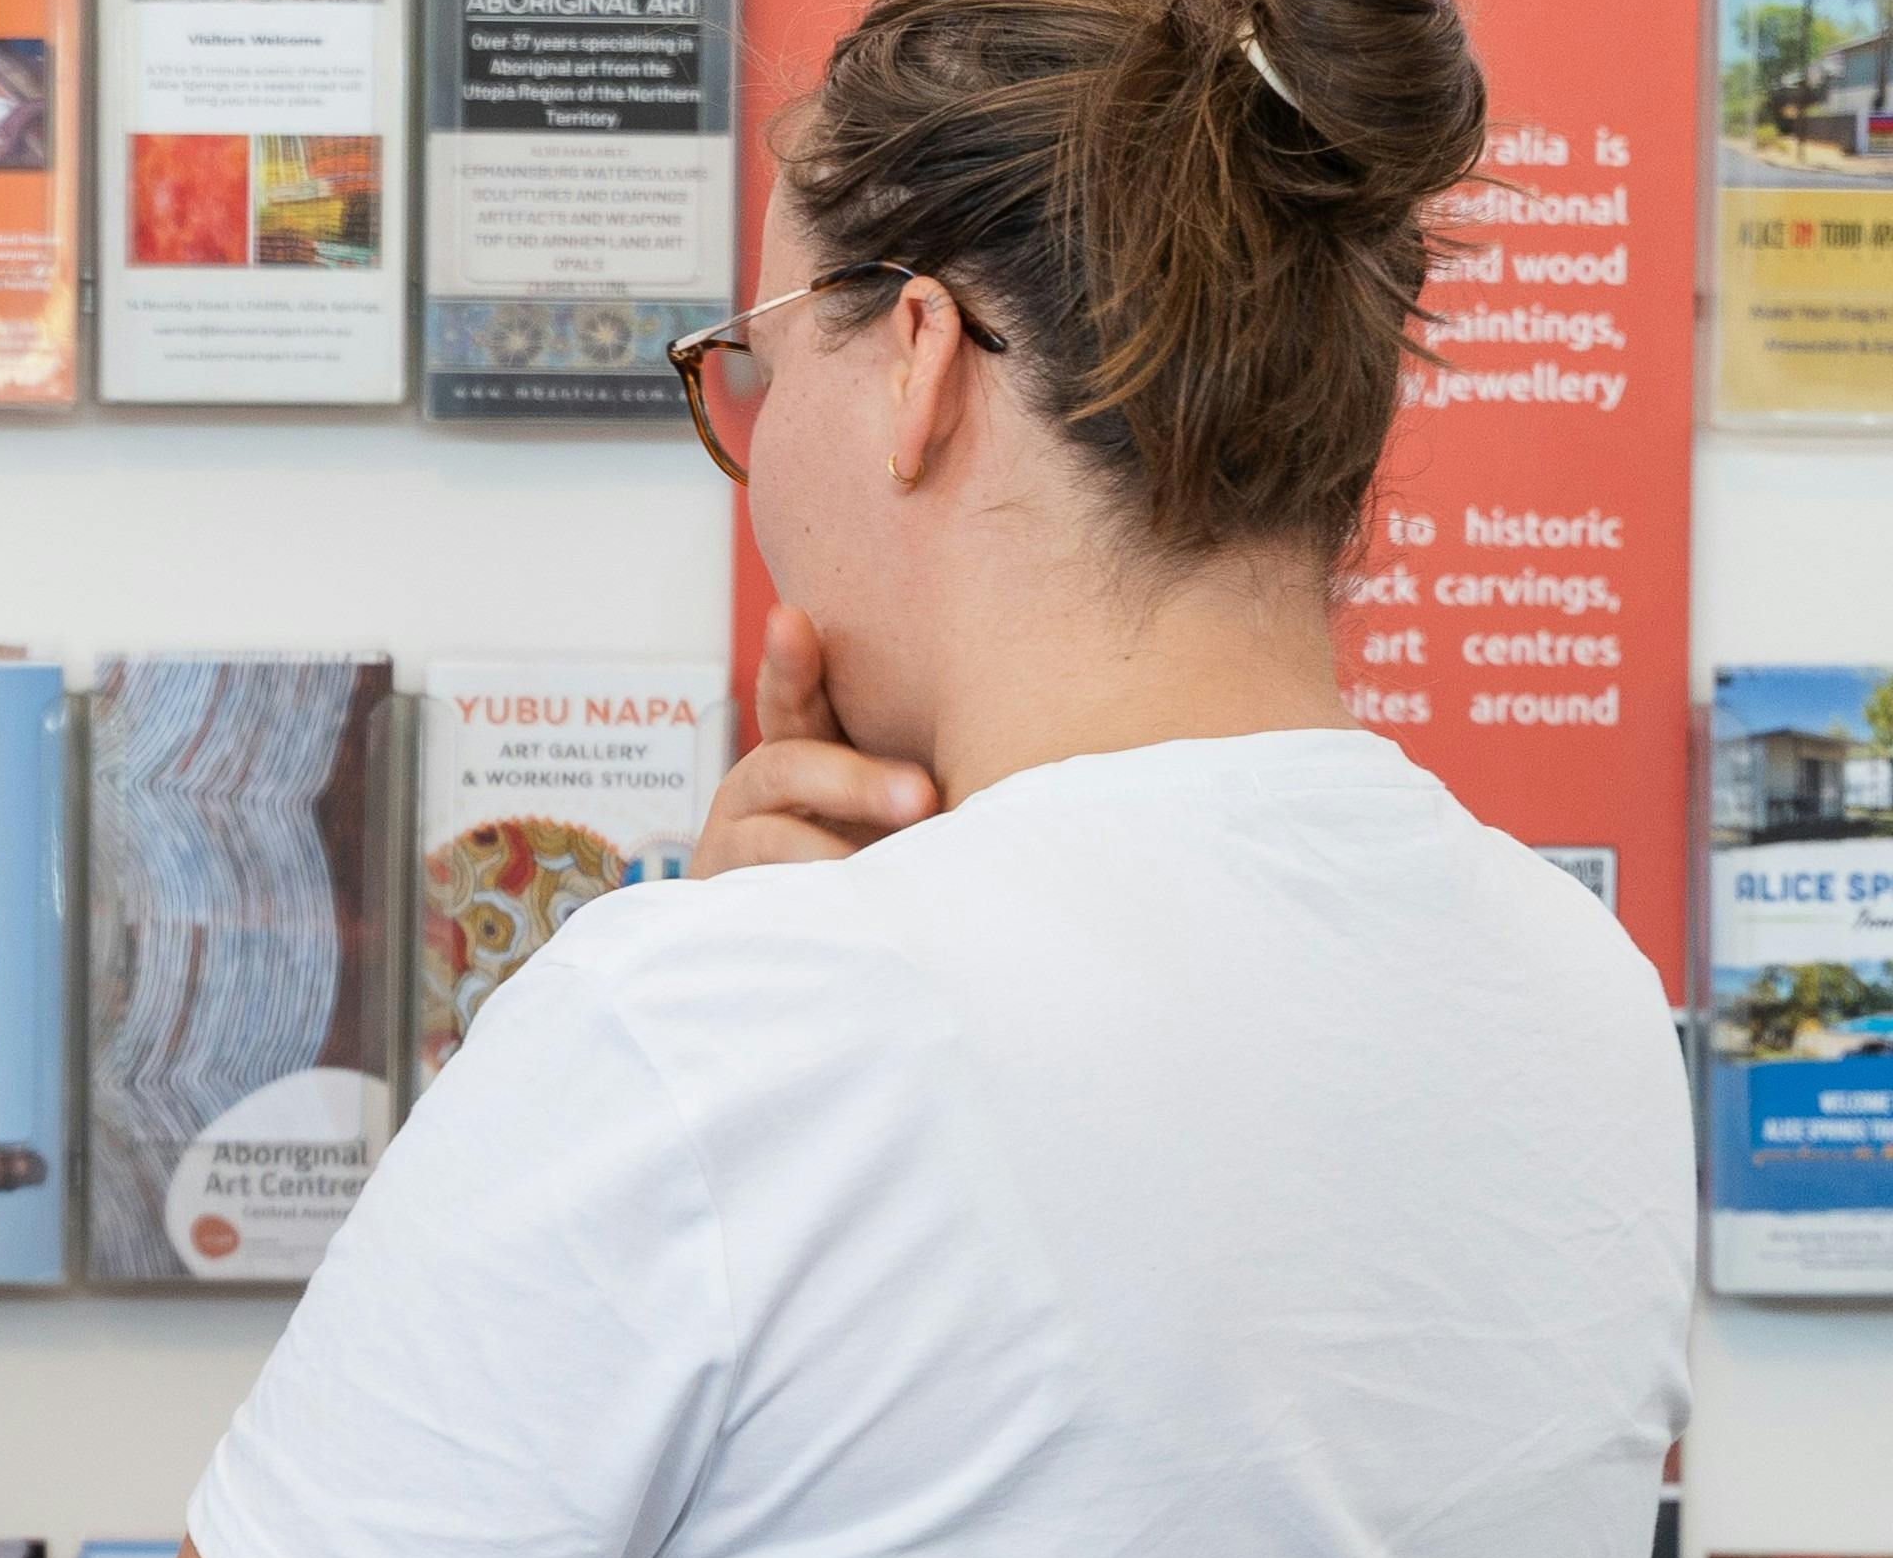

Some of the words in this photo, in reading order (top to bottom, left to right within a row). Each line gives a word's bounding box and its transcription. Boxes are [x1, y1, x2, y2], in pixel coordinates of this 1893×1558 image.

[490, 58, 571, 80] Aboriginal
[1595, 128, 1630, 167] is
[1512, 246, 1628, 285] wood
[1424, 304, 1625, 352] paintings,
[1388, 510, 1436, 546] to
[1464, 506, 1620, 548] historic
[1434, 568, 1620, 615] carvings,
[1363, 628, 1424, 664] art
[1462, 630, 1621, 666] centres
[455, 695, 571, 727] YUBU
[584, 696, 698, 728] NAPA
[1469, 686, 1619, 726] around
[499, 742, 541, 760] ART
[548, 743, 647, 760] GALLERY
[461, 769, 478, 787] &
[485, 770, 593, 787] WORKING
[602, 772, 685, 788] STUDIO
[1735, 871, 1835, 904] ALICE
[214, 1139, 371, 1174] Aboriginal
[204, 1170, 252, 1198] Art
